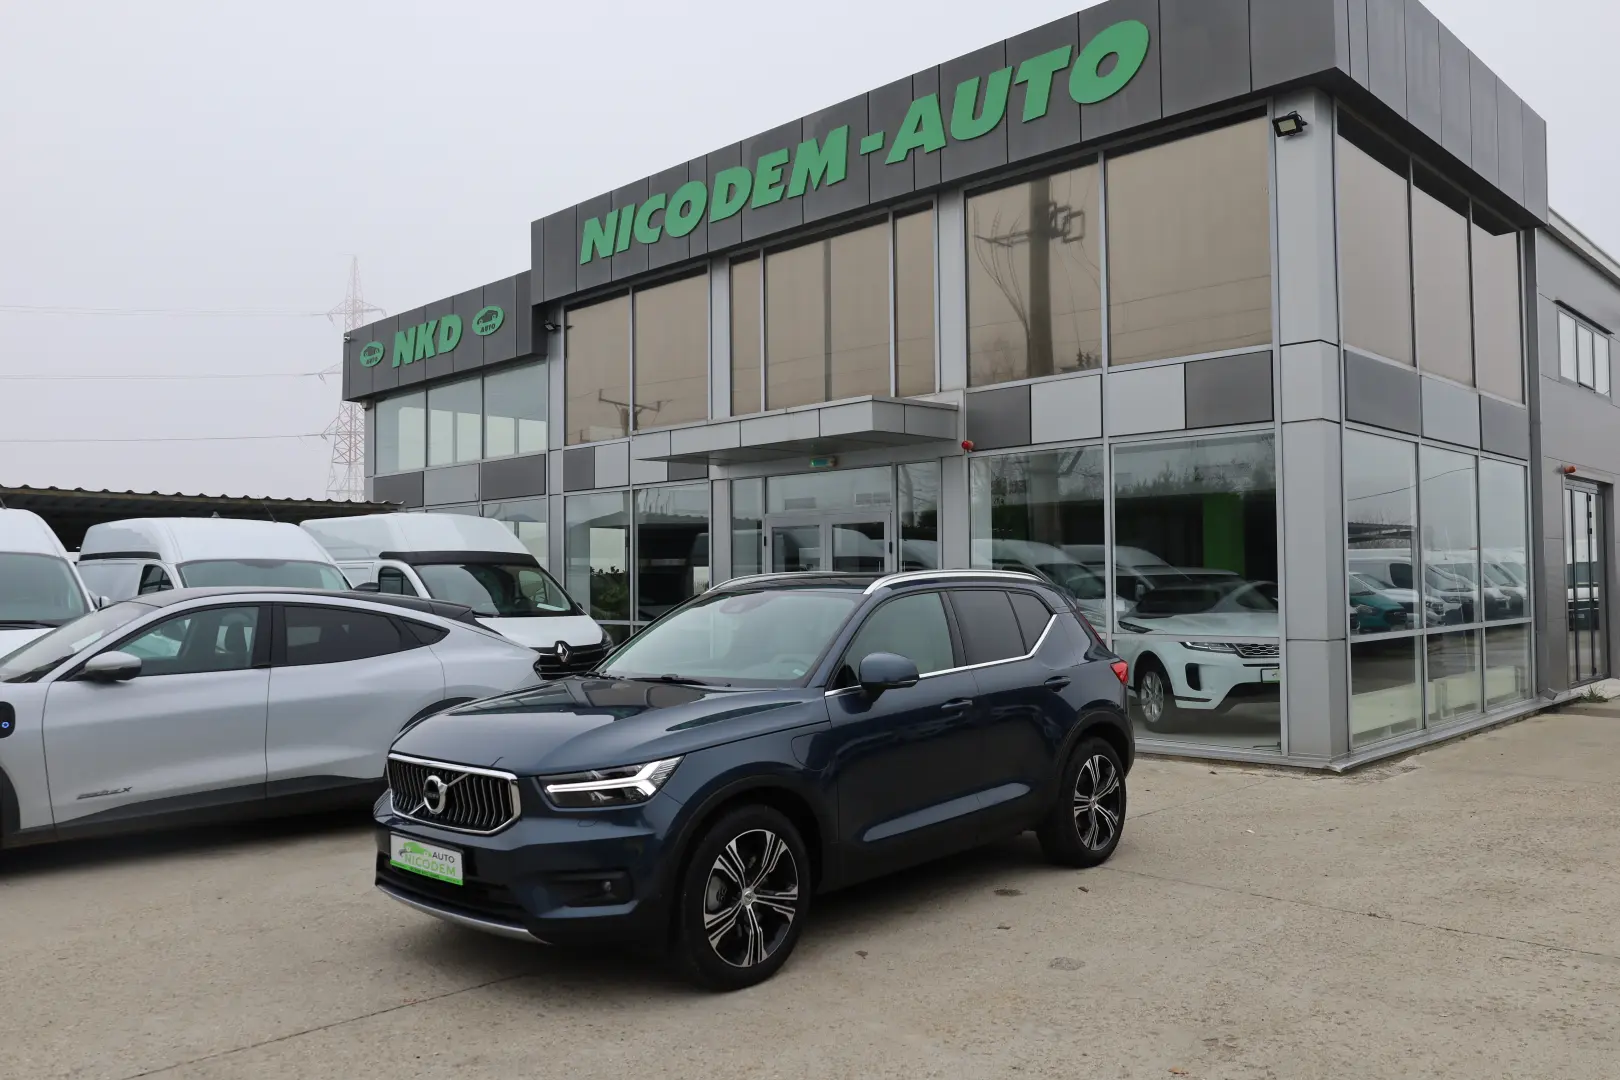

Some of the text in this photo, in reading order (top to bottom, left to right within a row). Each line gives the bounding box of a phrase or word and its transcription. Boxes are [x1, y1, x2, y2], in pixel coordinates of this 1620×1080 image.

[480, 323, 496, 334] AUTO
[392, 314, 463, 368] NKD
[404, 853, 457, 877] NICODEM
[432, 851, 456, 864] AUTO
